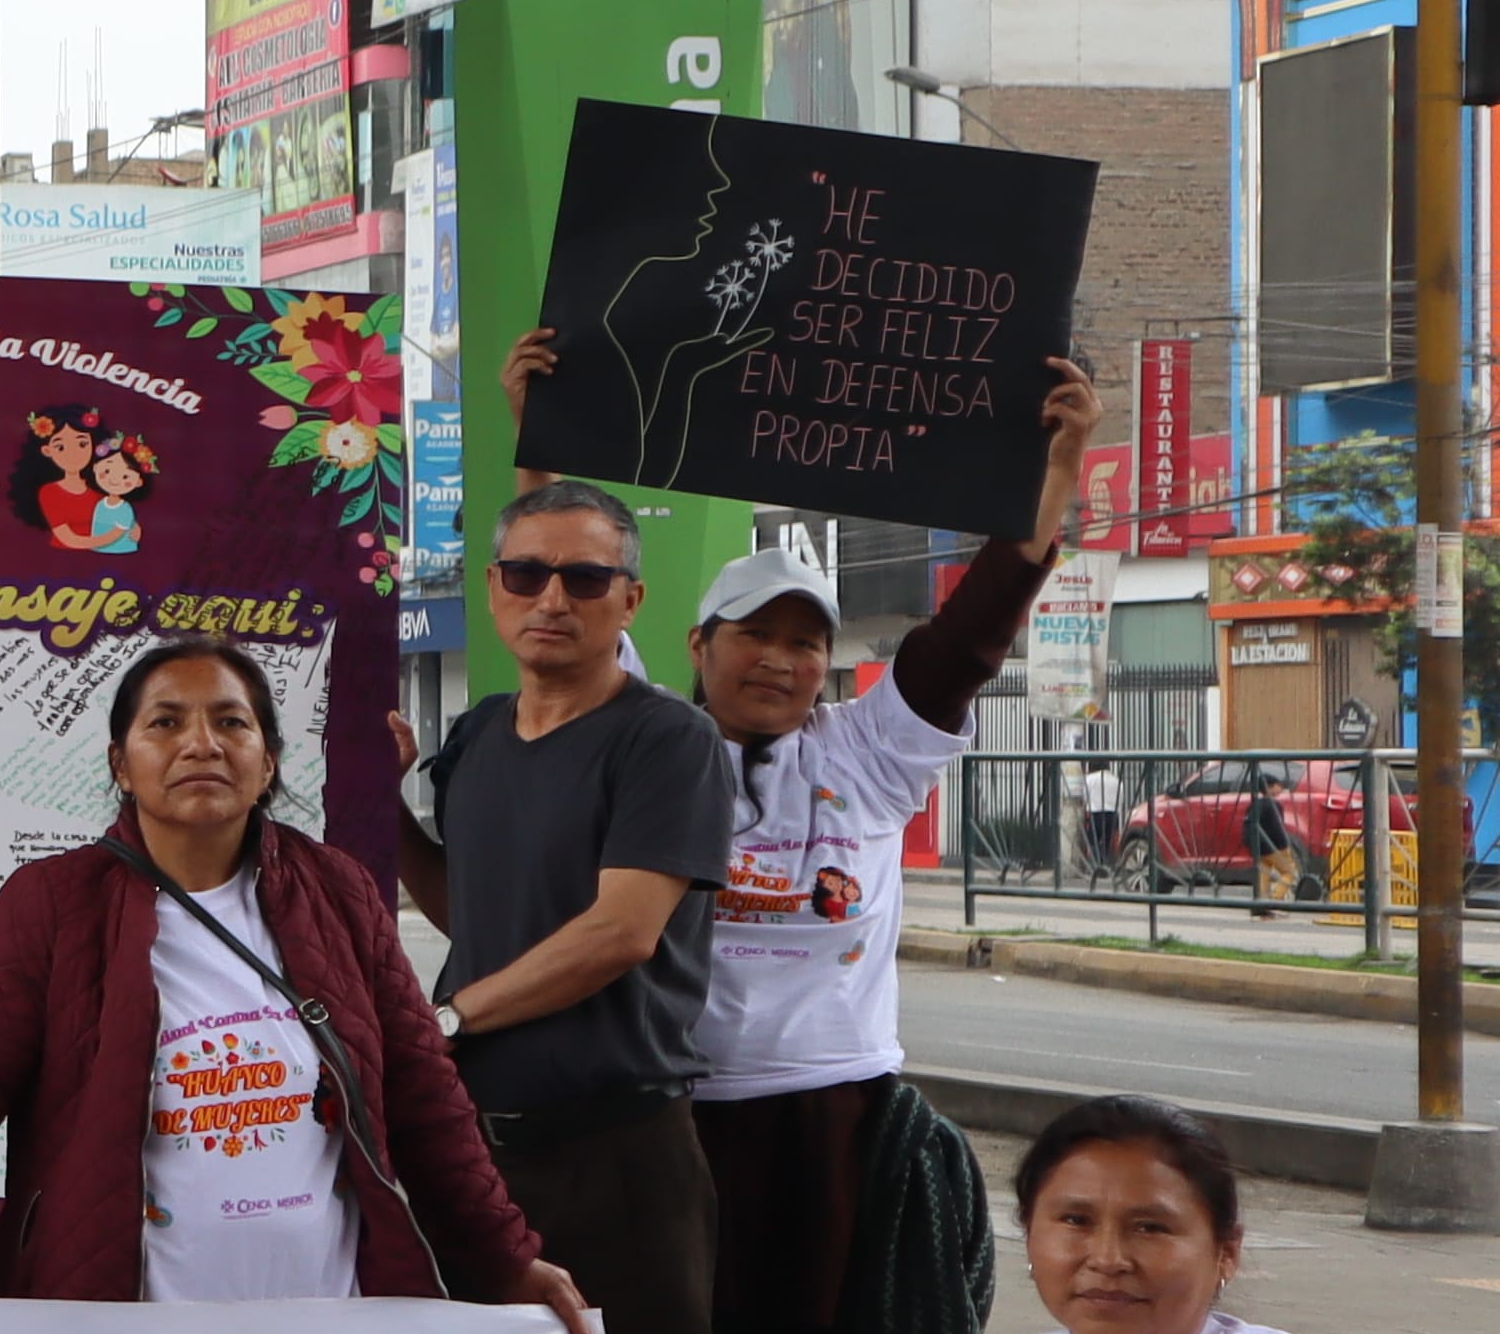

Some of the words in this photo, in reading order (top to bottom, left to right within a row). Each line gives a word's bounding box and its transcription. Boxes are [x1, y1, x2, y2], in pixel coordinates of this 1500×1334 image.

[0, 202, 60, 228] Rosa
[70, 202, 147, 230] Salud
[110, 257, 245, 272] ESPECIALIDADES
[174, 243, 245, 258] Nuestras
[810, 248, 1015, 314] DECIDIDO
[789, 299, 864, 349] SER
[879, 316, 1000, 364] FELIZ
[30, 338, 203, 415] Violencia
[740, 350, 797, 398] EN
[815, 359, 995, 419] DEFENSA
[415, 419, 462, 439] Pam
[1157, 344, 1174, 516] RESTAURANTE
[1034, 617, 1106, 631] NUEVAS
